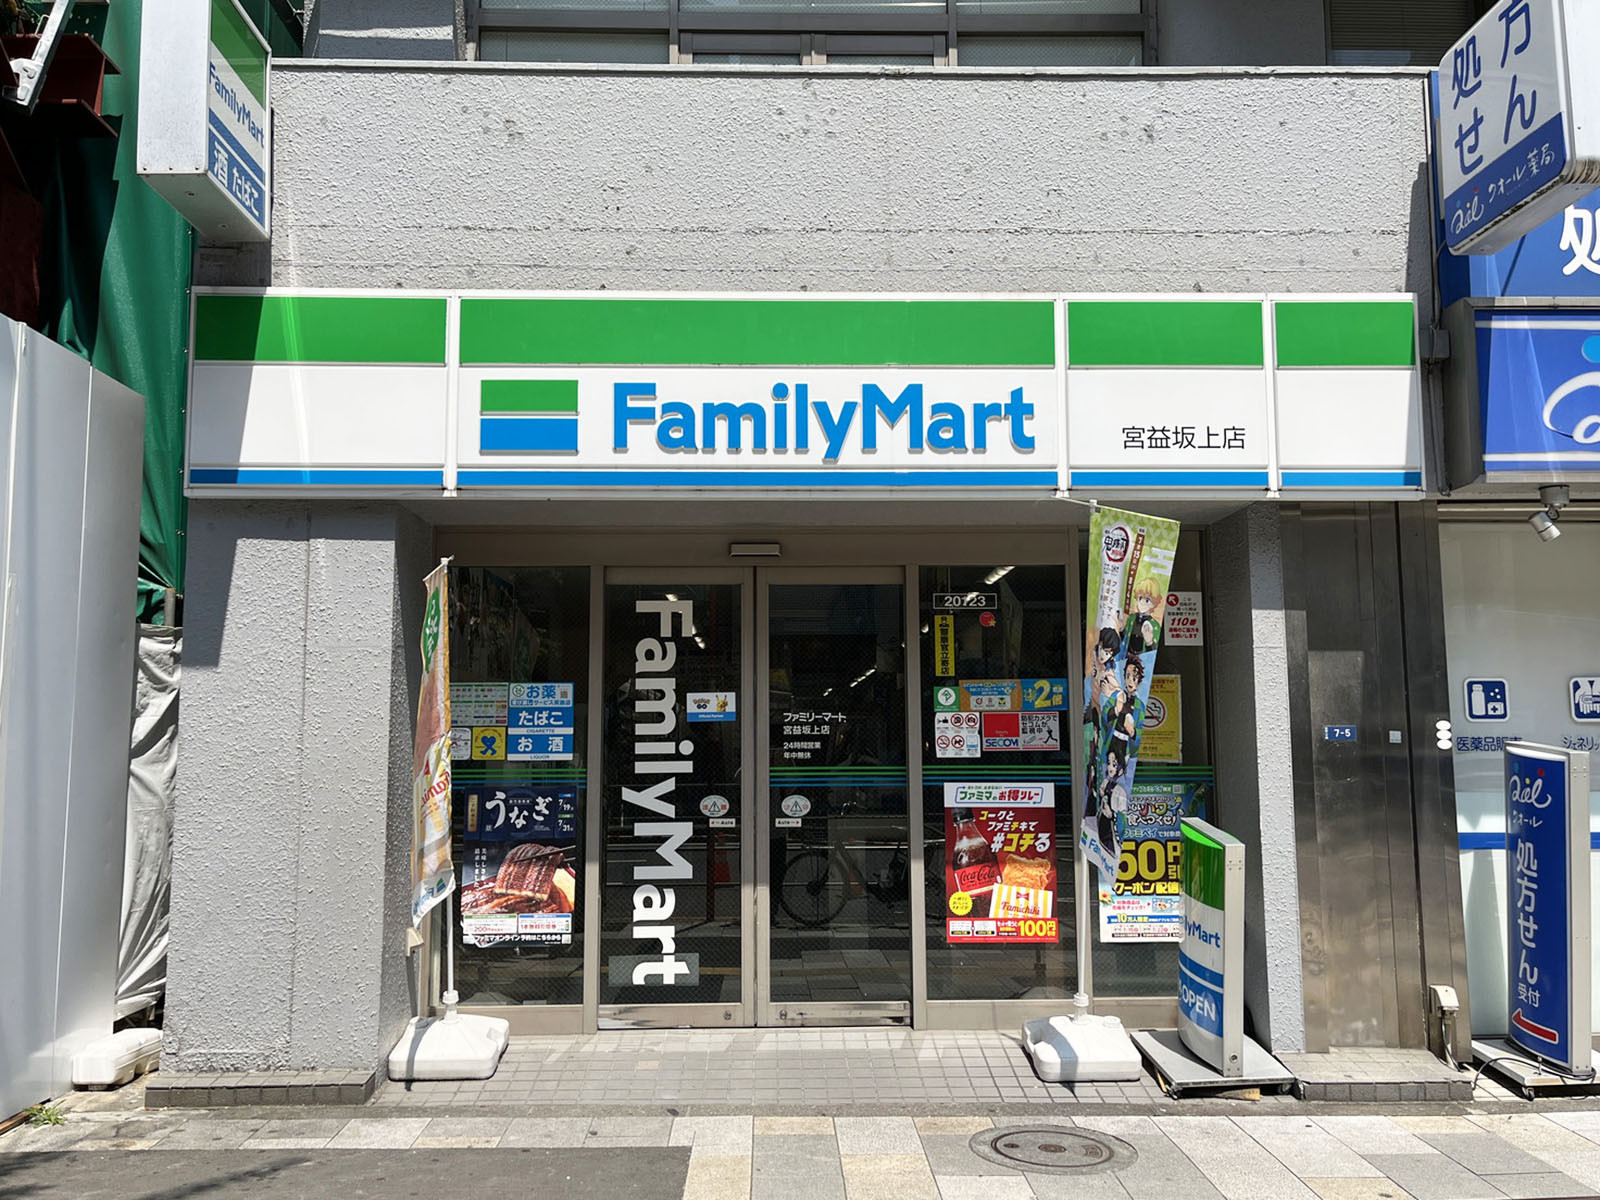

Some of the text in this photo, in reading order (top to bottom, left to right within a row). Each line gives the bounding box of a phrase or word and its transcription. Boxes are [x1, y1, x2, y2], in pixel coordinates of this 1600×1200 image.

[208, 61, 265, 149] FamilyMart
[213, 140, 260, 218] 酒 たばこ
[1488, 142, 1556, 204] クオール薬局
[612, 382, 1036, 465] FamilyMart
[1122, 425, 1246, 450] 宮益坂上店
[943, 595, 987, 607] 20123
[525, 684, 557, 699] お薬
[518, 710, 564, 726] たばこ
[783, 725, 831, 735] 宮益坂上店
[1333, 728, 1352, 738] 7-5
[783, 741, 822, 750] 24時間営業
[985, 738, 1019, 748] SECOM
[1456, 736, 1522, 752] 医薬品販
[783, 751, 812, 760] 年中無休
[621, 599, 694, 985] FamilyMart
[959, 789, 1041, 802] ファミマのお得リレー
[485, 790, 553, 829] うなぎ
[979, 810, 1016, 821] コークと
[1516, 837, 1539, 986] 処方せん
[1182, 983, 1216, 1022] OPEN
[1517, 983, 1541, 1008] 受付
